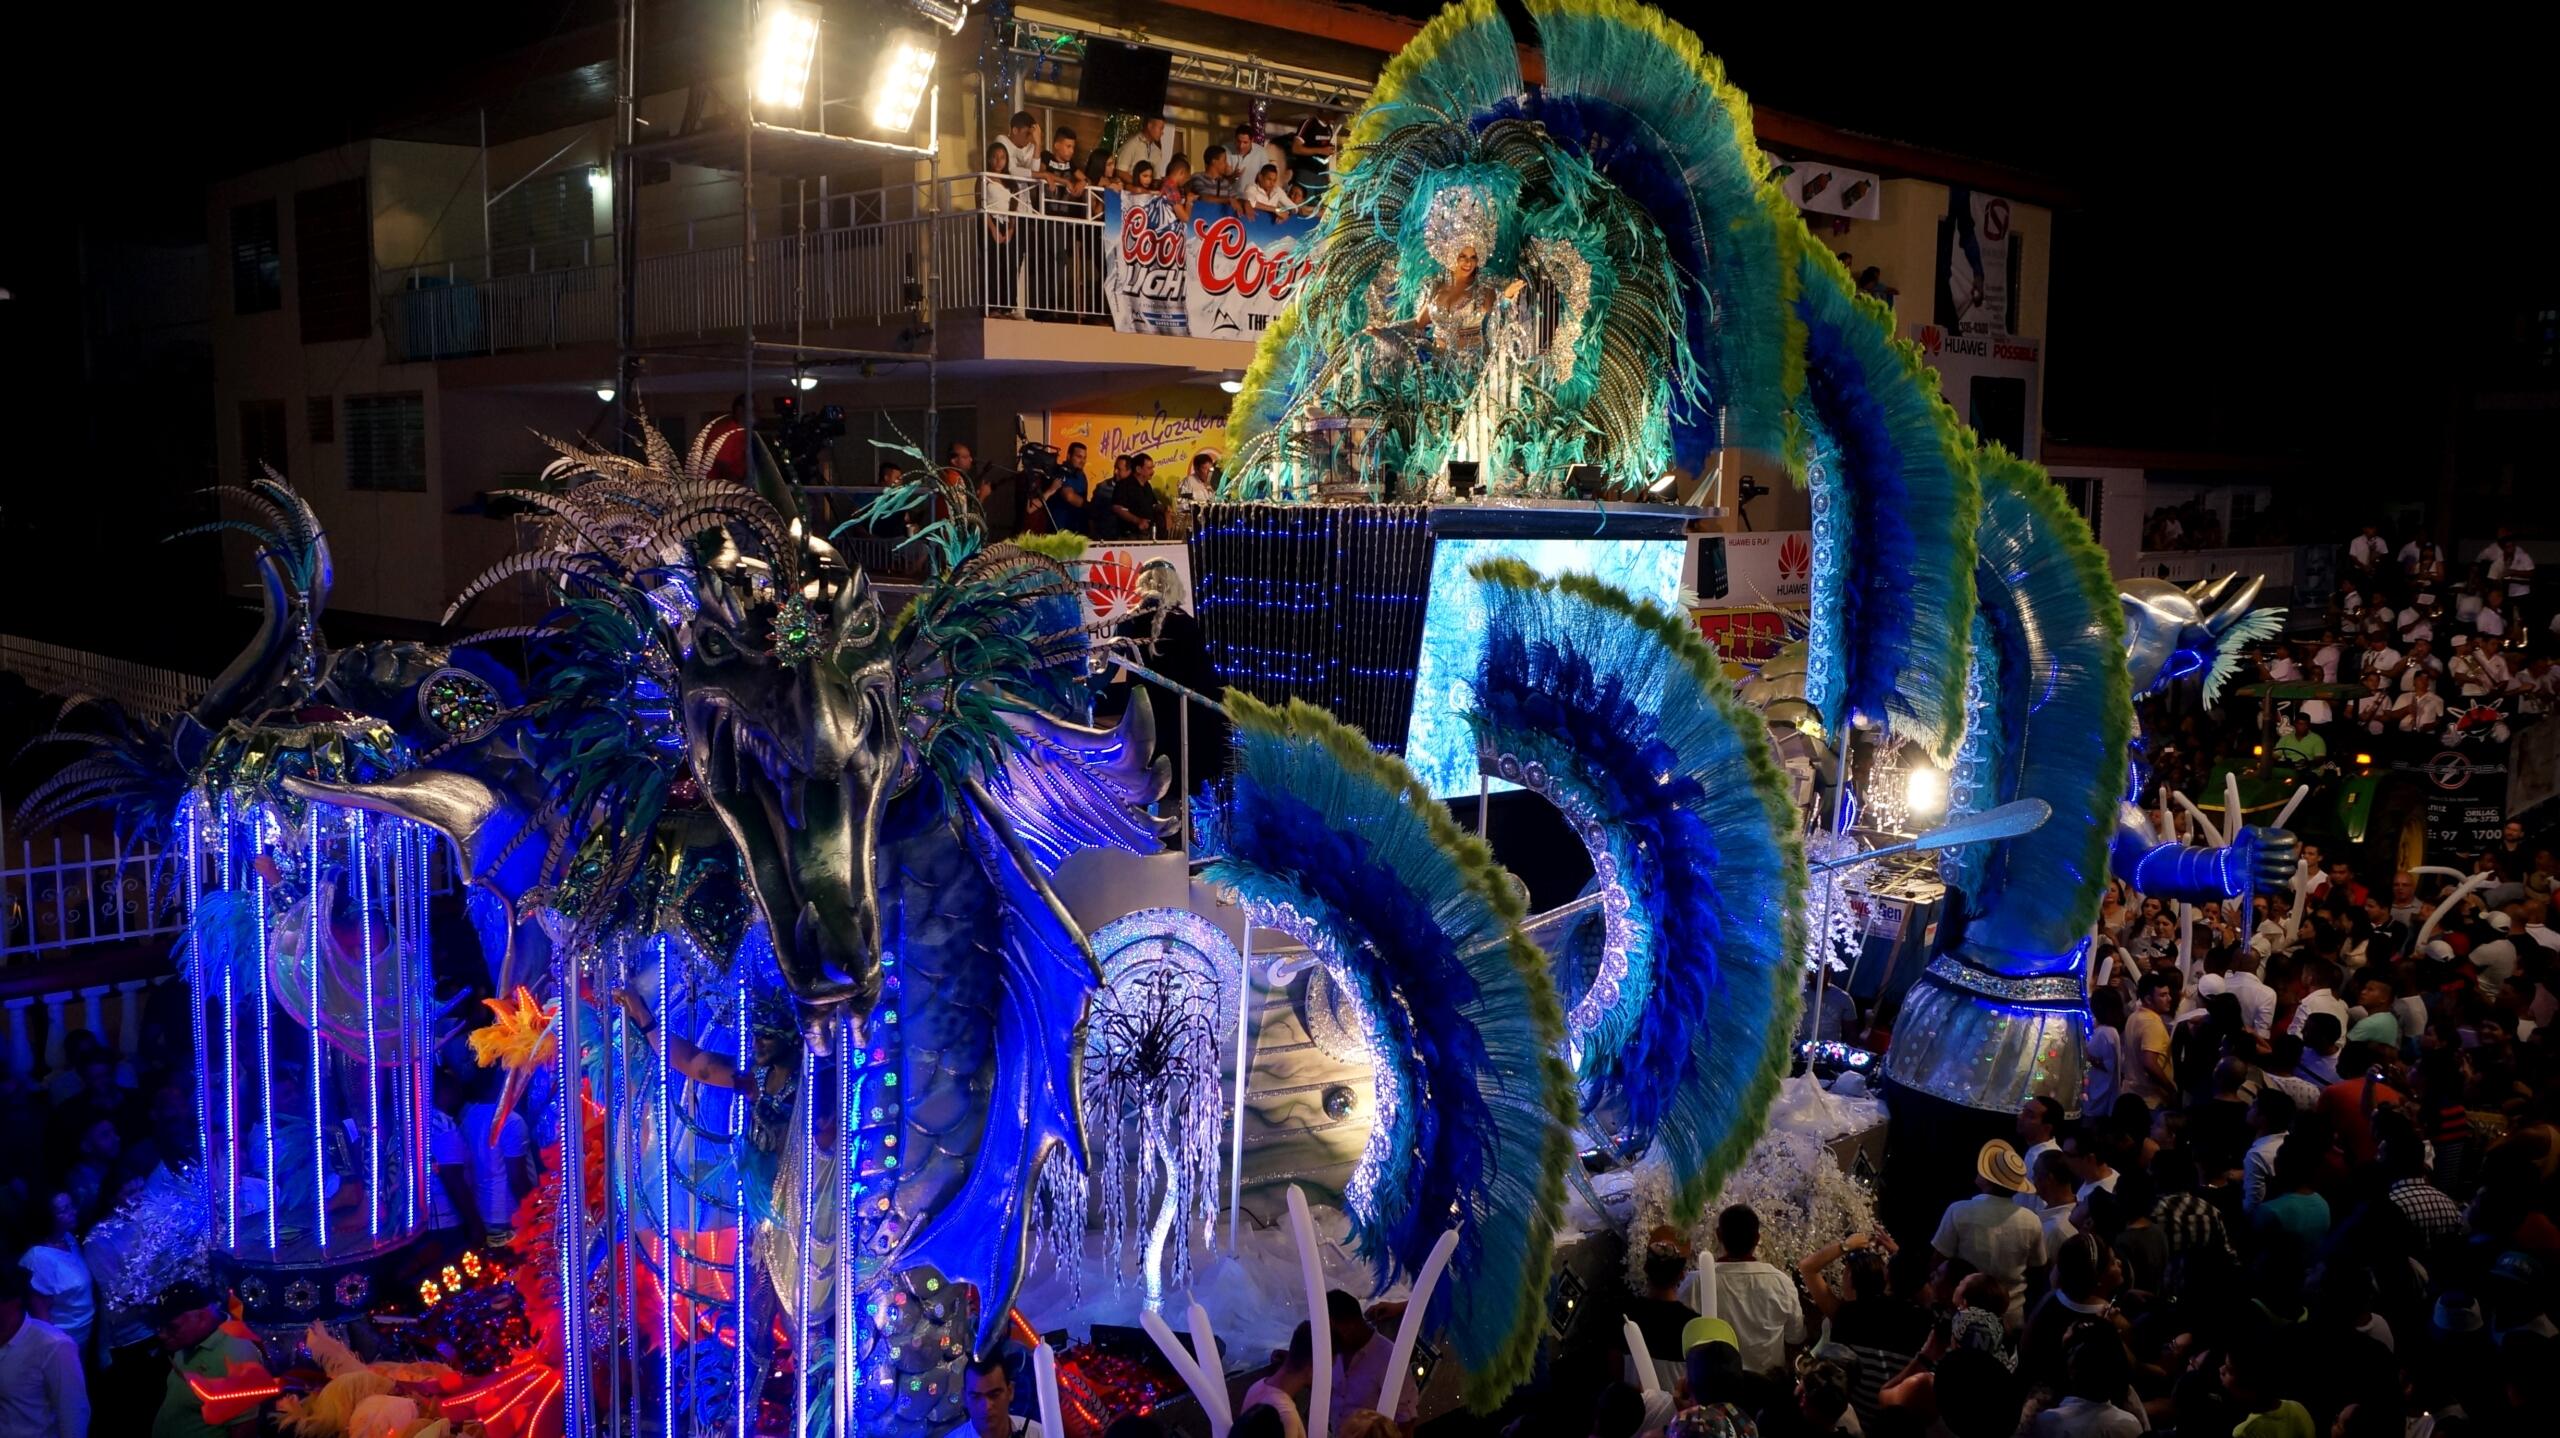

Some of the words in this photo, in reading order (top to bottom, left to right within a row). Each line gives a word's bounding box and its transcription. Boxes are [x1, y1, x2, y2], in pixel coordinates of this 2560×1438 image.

[1123, 265, 1187, 301] LIGH
[1945, 338, 1987, 356] HUAWEI
[1777, 583, 1808, 596] HUAWEI
